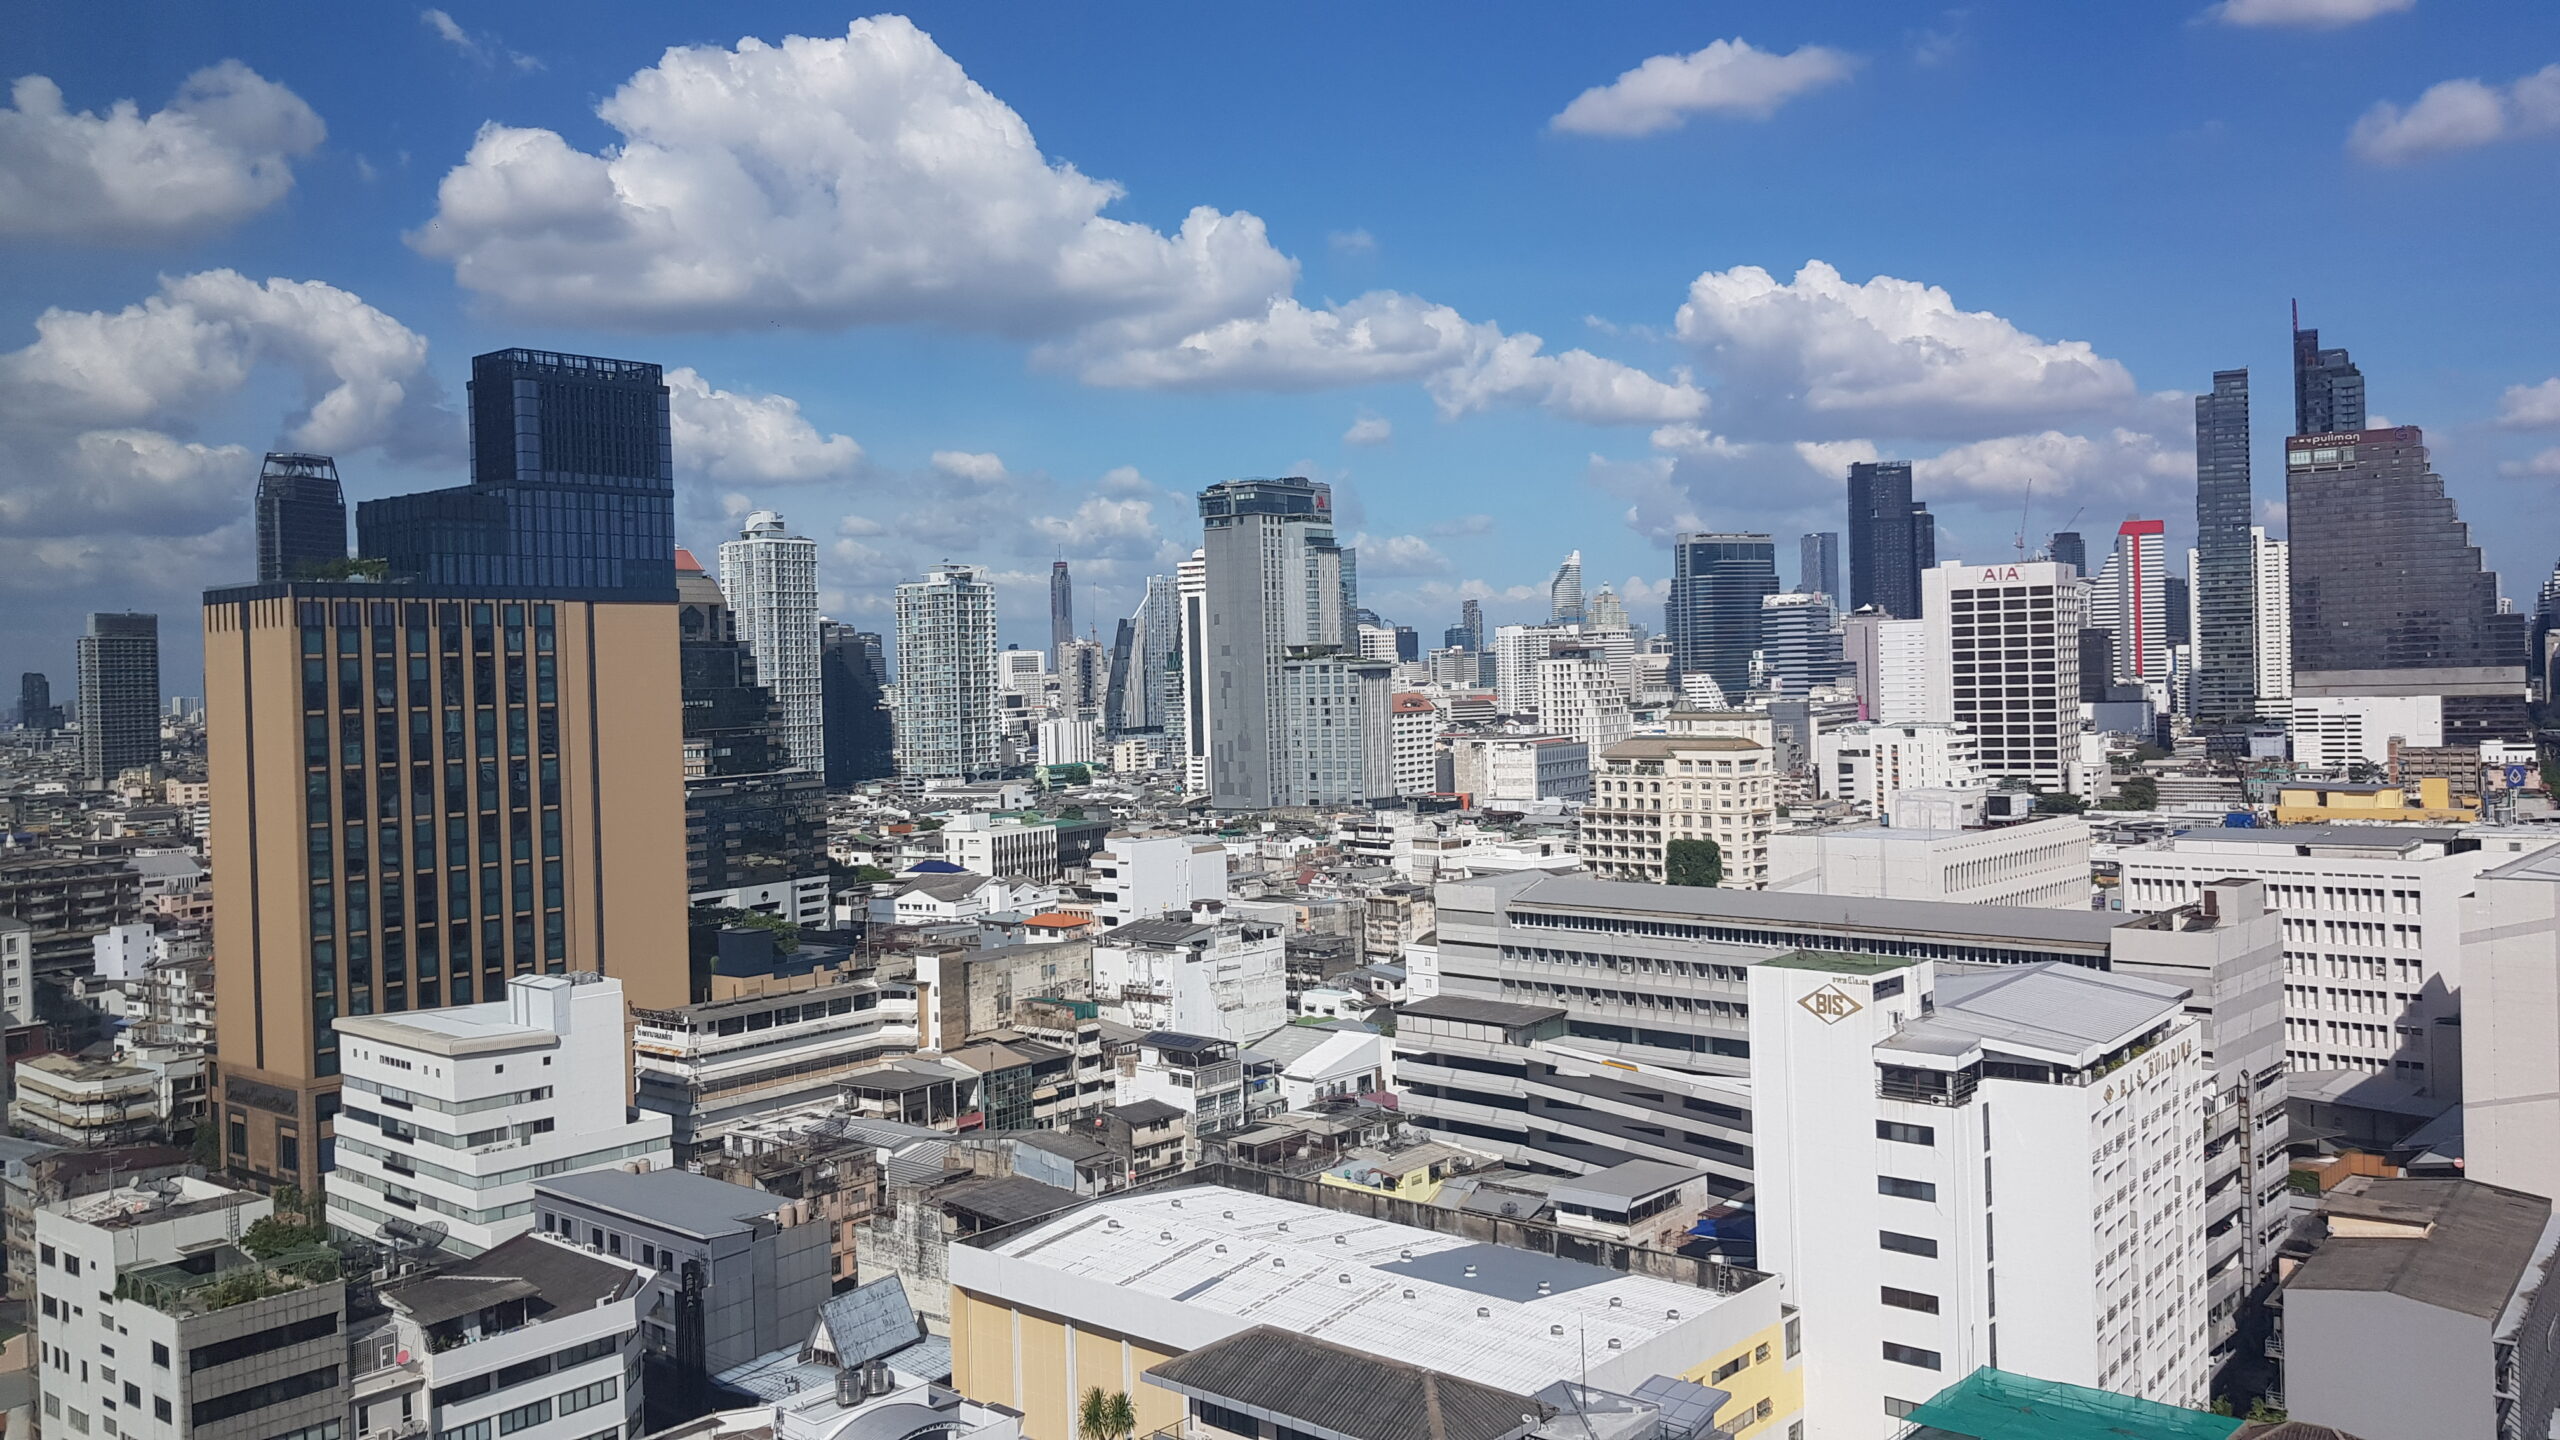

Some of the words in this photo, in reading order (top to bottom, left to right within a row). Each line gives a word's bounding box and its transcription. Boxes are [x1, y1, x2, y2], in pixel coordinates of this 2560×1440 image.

[2312, 433, 2360, 445] pullman
[1983, 567, 2019, 581] AIA
[1816, 993, 1843, 1016] BIS
[2149, 1038, 2192, 1079] BUILDING
